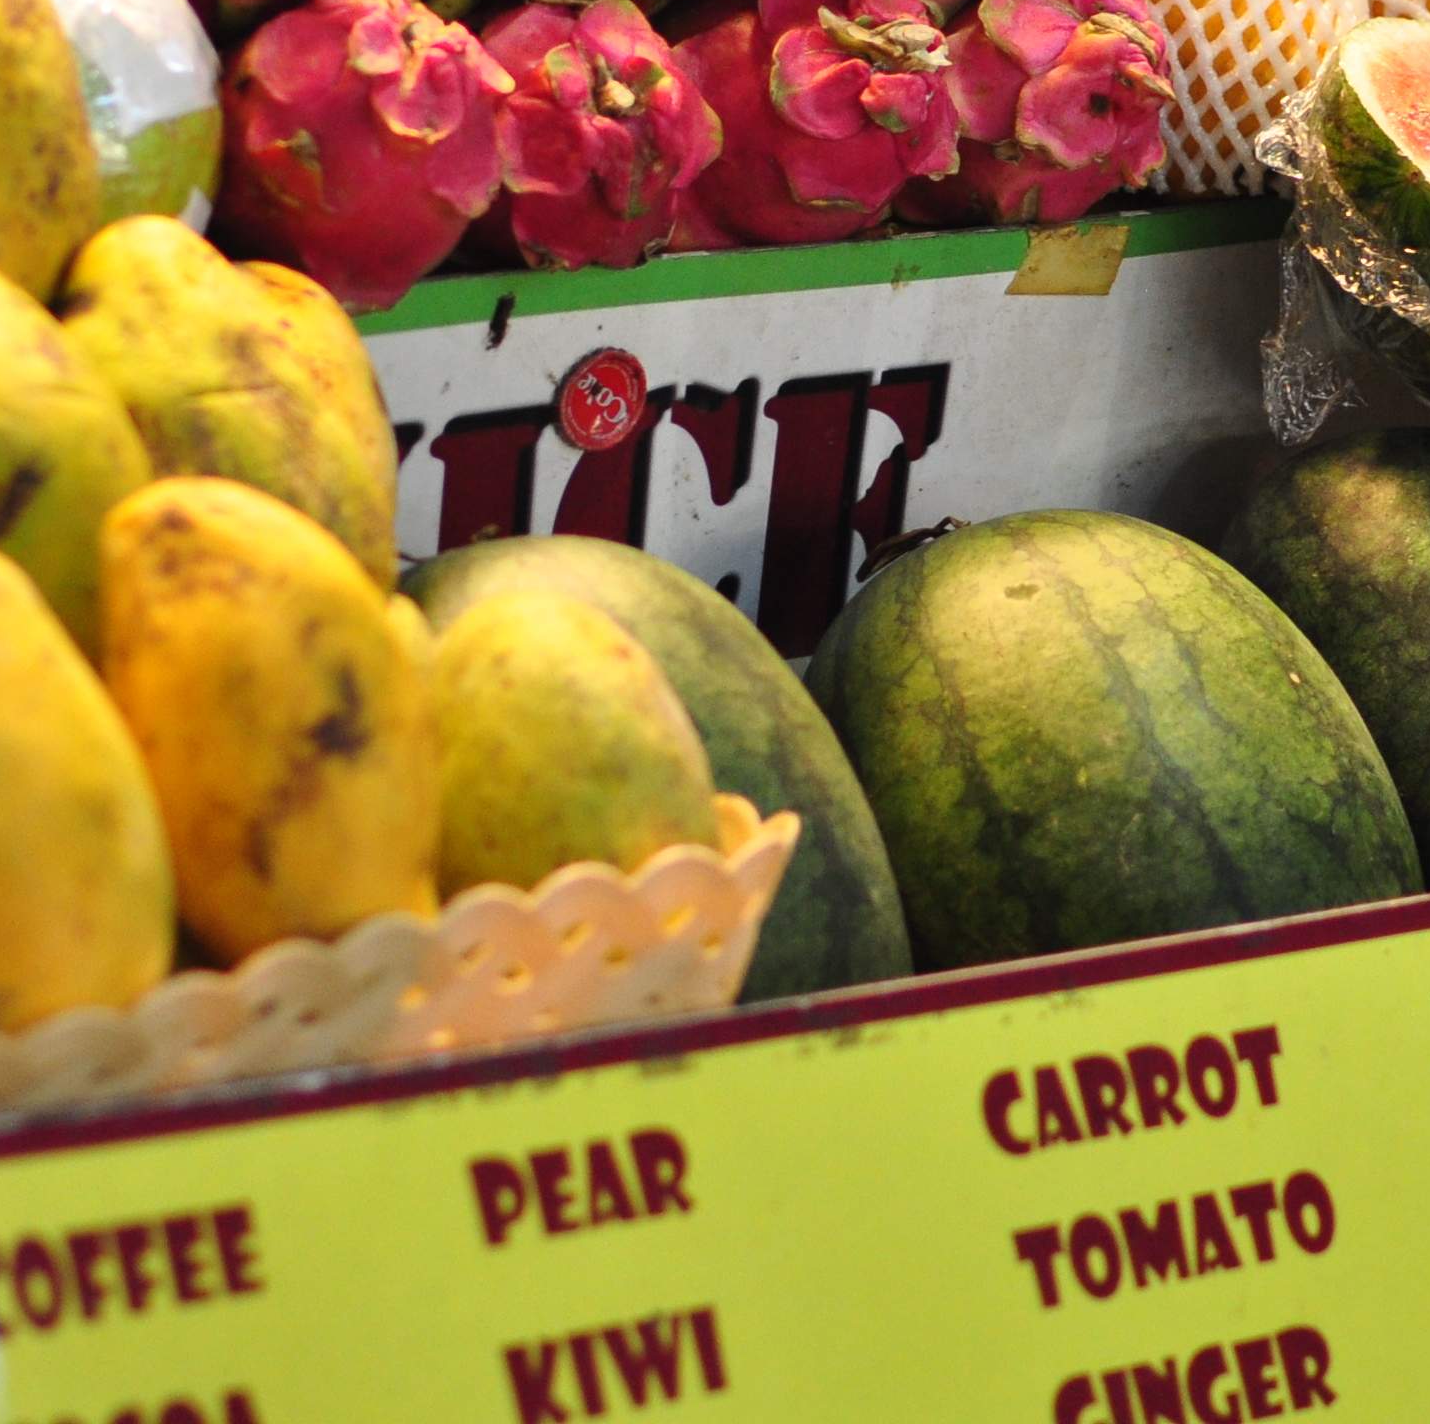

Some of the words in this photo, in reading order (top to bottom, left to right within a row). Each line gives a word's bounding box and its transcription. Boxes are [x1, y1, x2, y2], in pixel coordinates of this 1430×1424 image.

[981, 1024, 1283, 1157] CARROT
[467, 1128, 694, 1247] PEAR
[1012, 1169, 1337, 1309] TOMATO
[501, 1306, 730, 1424] KIWI
[1053, 1325, 1339, 1424] GINGER
